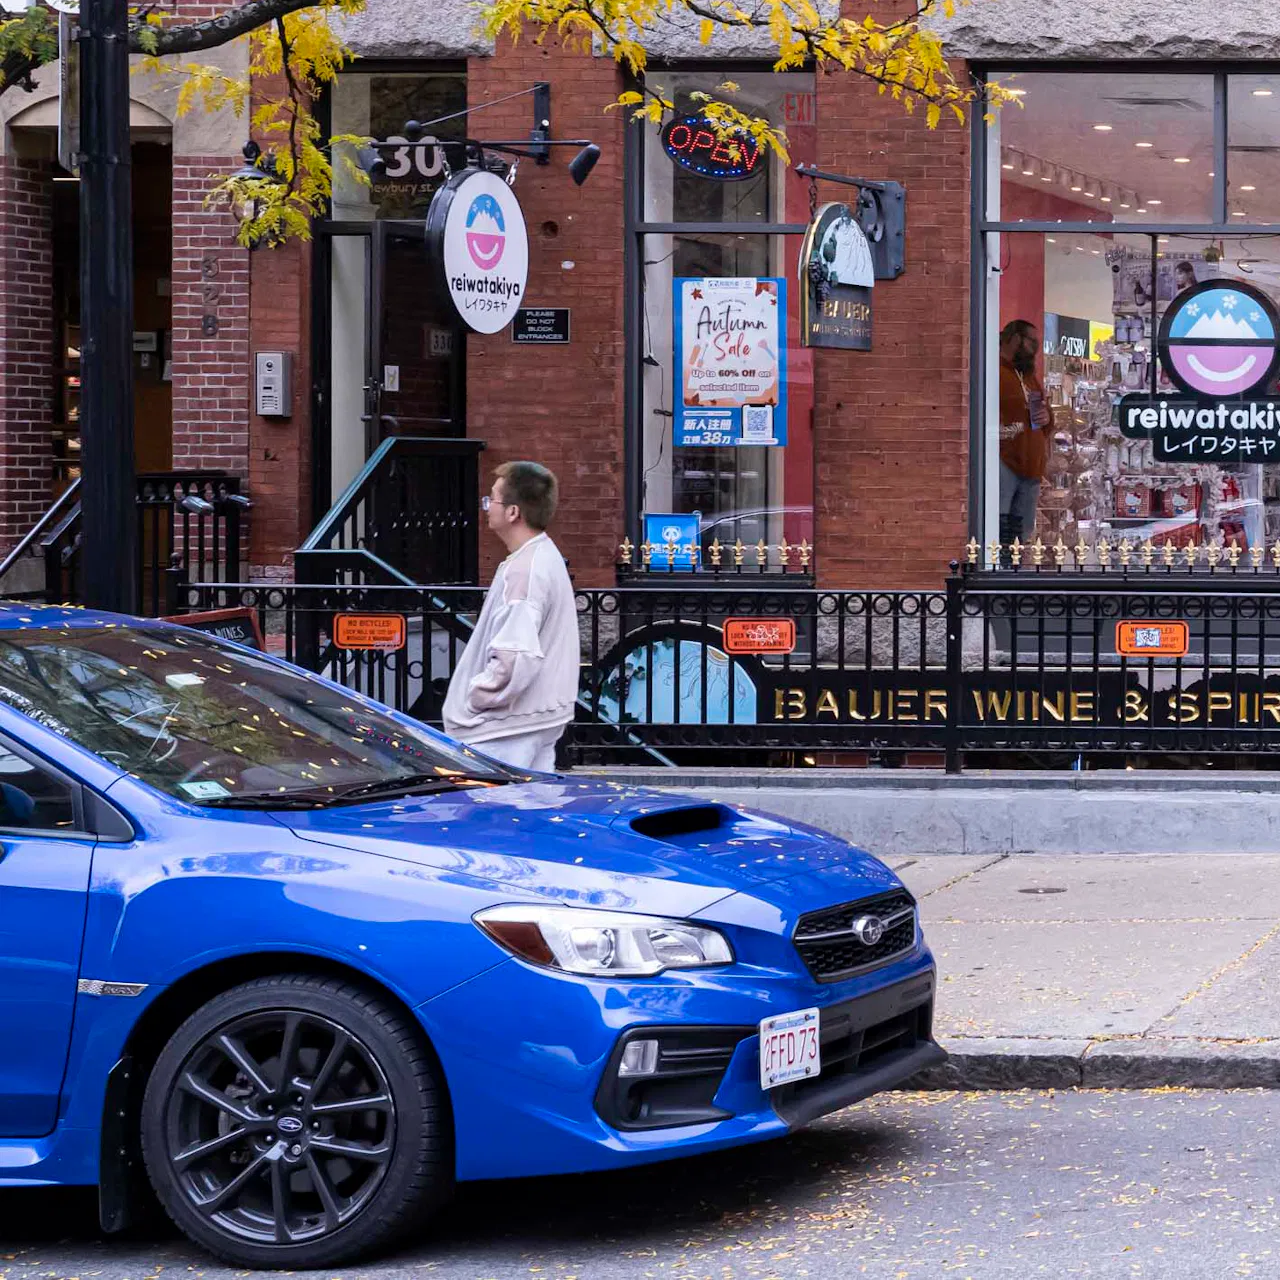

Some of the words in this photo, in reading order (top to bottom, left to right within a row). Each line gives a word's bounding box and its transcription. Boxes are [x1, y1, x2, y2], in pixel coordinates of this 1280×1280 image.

[785, 93, 812, 121] EXI
[371, 136, 442, 178] 30
[669, 125, 759, 170] OPEN
[451, 273, 520, 300] reiwatakiya
[465, 299, 508, 312] レイワタキヤ
[526, 310, 555, 318] PLEASE
[697, 304, 768, 339] Autumn
[713, 332, 751, 361] Sale
[1163, 435, 1276, 455] レイワタキヤ
[214, 625, 245, 639] WINES
[774, 687, 947, 720] BAUER
[972, 689, 1100, 721] WINE
[1117, 691, 1149, 721] &
[764, 1031, 795, 1072] 2FFD
[799, 1027, 817, 1063] 73
